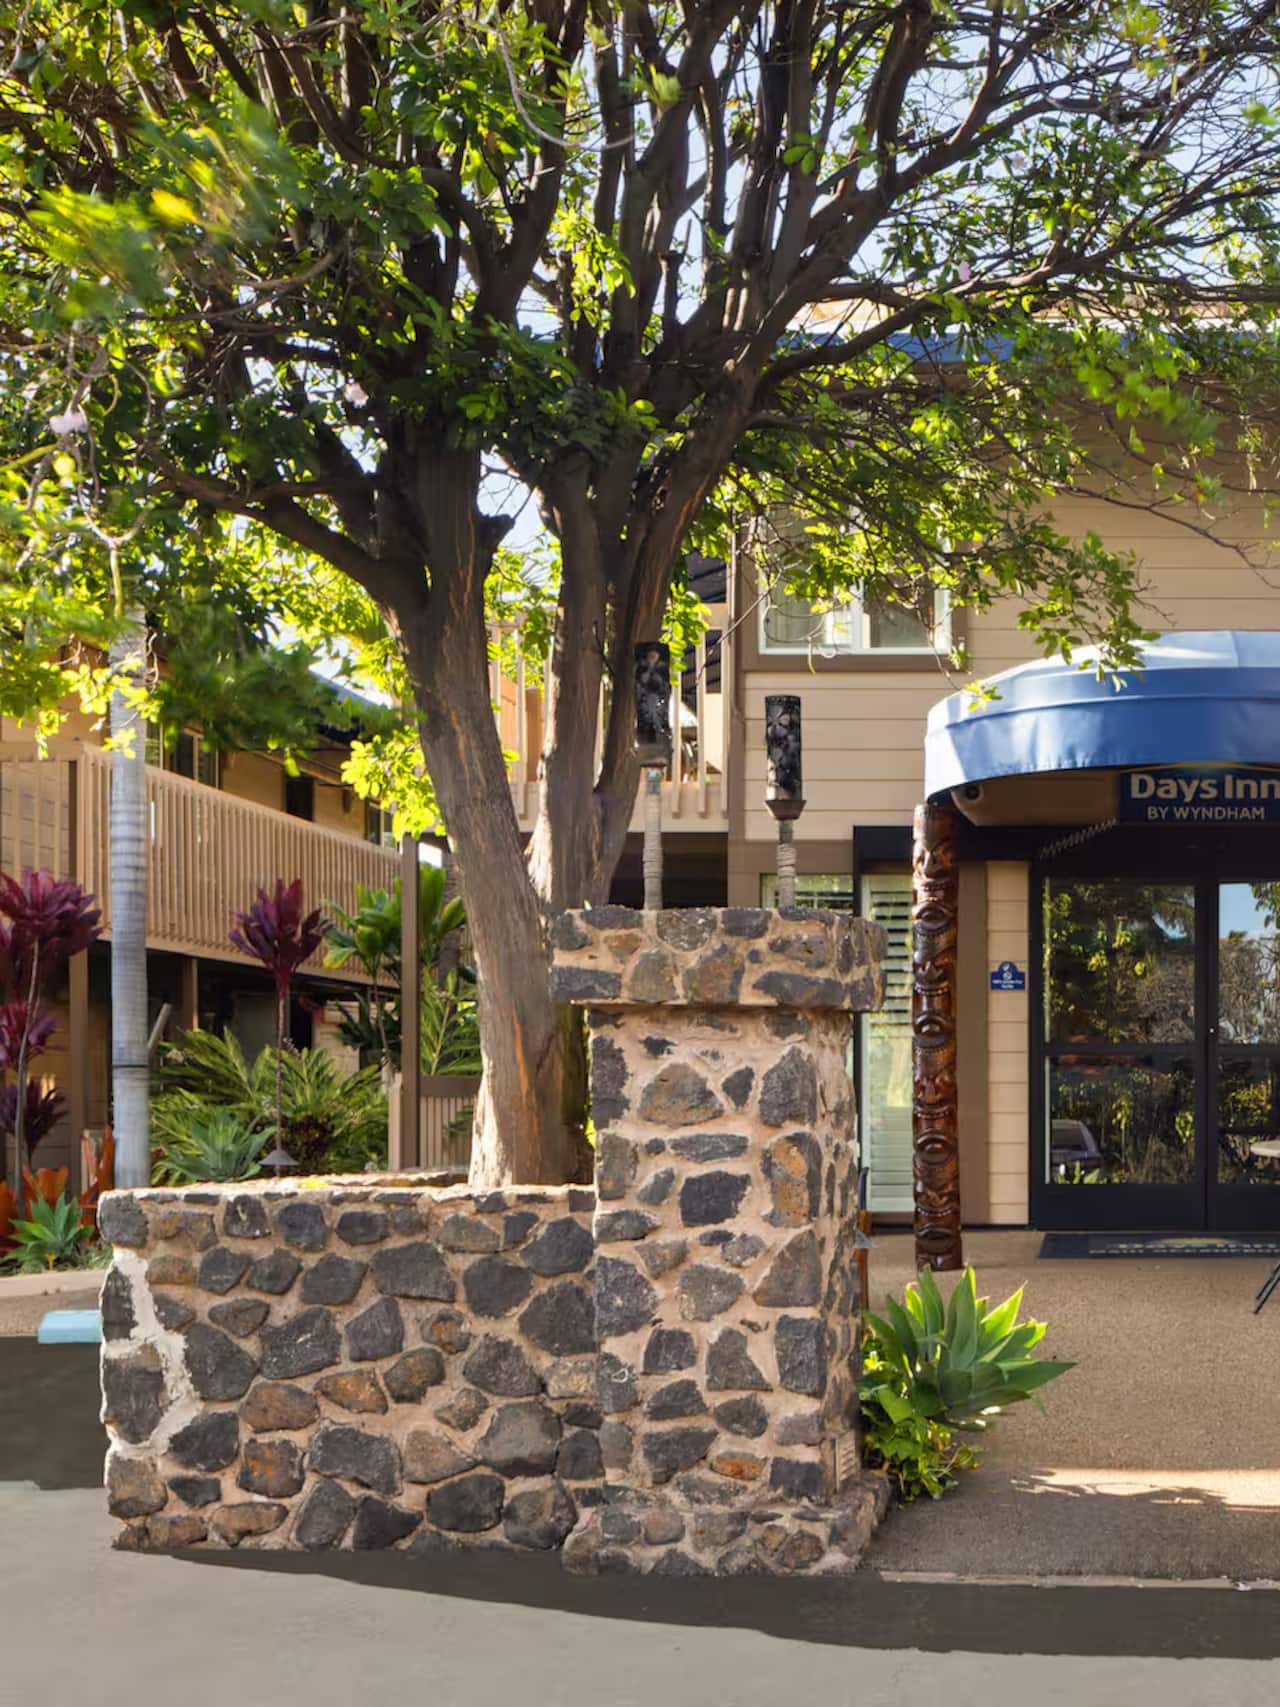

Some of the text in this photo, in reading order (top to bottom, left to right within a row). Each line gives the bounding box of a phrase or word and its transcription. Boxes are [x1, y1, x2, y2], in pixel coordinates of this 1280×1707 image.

[1131, 773, 1218, 803] Days
[1147, 806, 1265, 820] BY WYNDHAM
